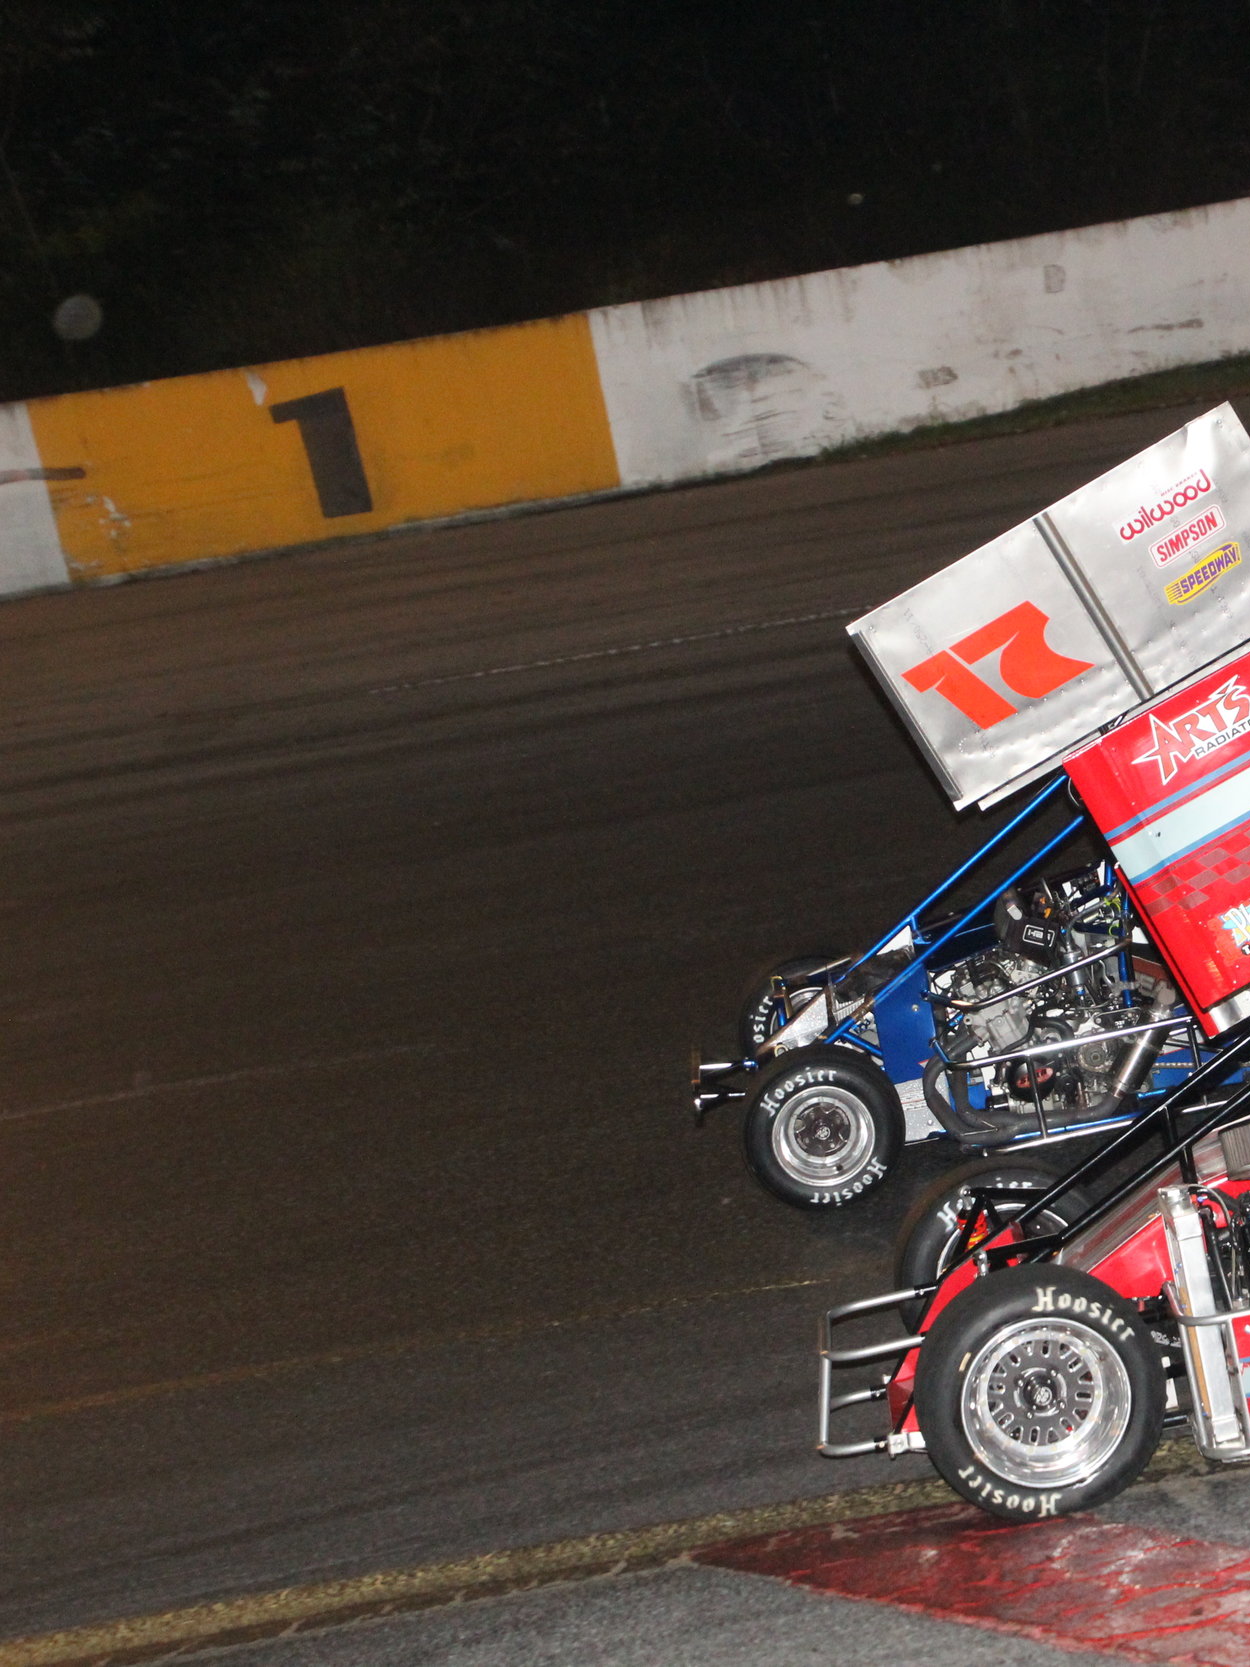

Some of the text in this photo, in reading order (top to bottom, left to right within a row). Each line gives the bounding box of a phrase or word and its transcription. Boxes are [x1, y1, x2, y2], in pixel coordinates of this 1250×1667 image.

[268, 386, 373, 519] 1
[1119, 468, 1212, 541] wilwood
[1156, 511, 1218, 562] SIMPSON
[1179, 546, 1238, 597] SPEEDWAY
[900, 599, 1096, 730] 17
[752, 996, 773, 1044] osier
[759, 1066, 838, 1118] Hoosier
[809, 1156, 888, 1207] Hoosier
[1031, 1285, 1137, 1342] Hoosier
[956, 1464, 1063, 1518] Hoosier
